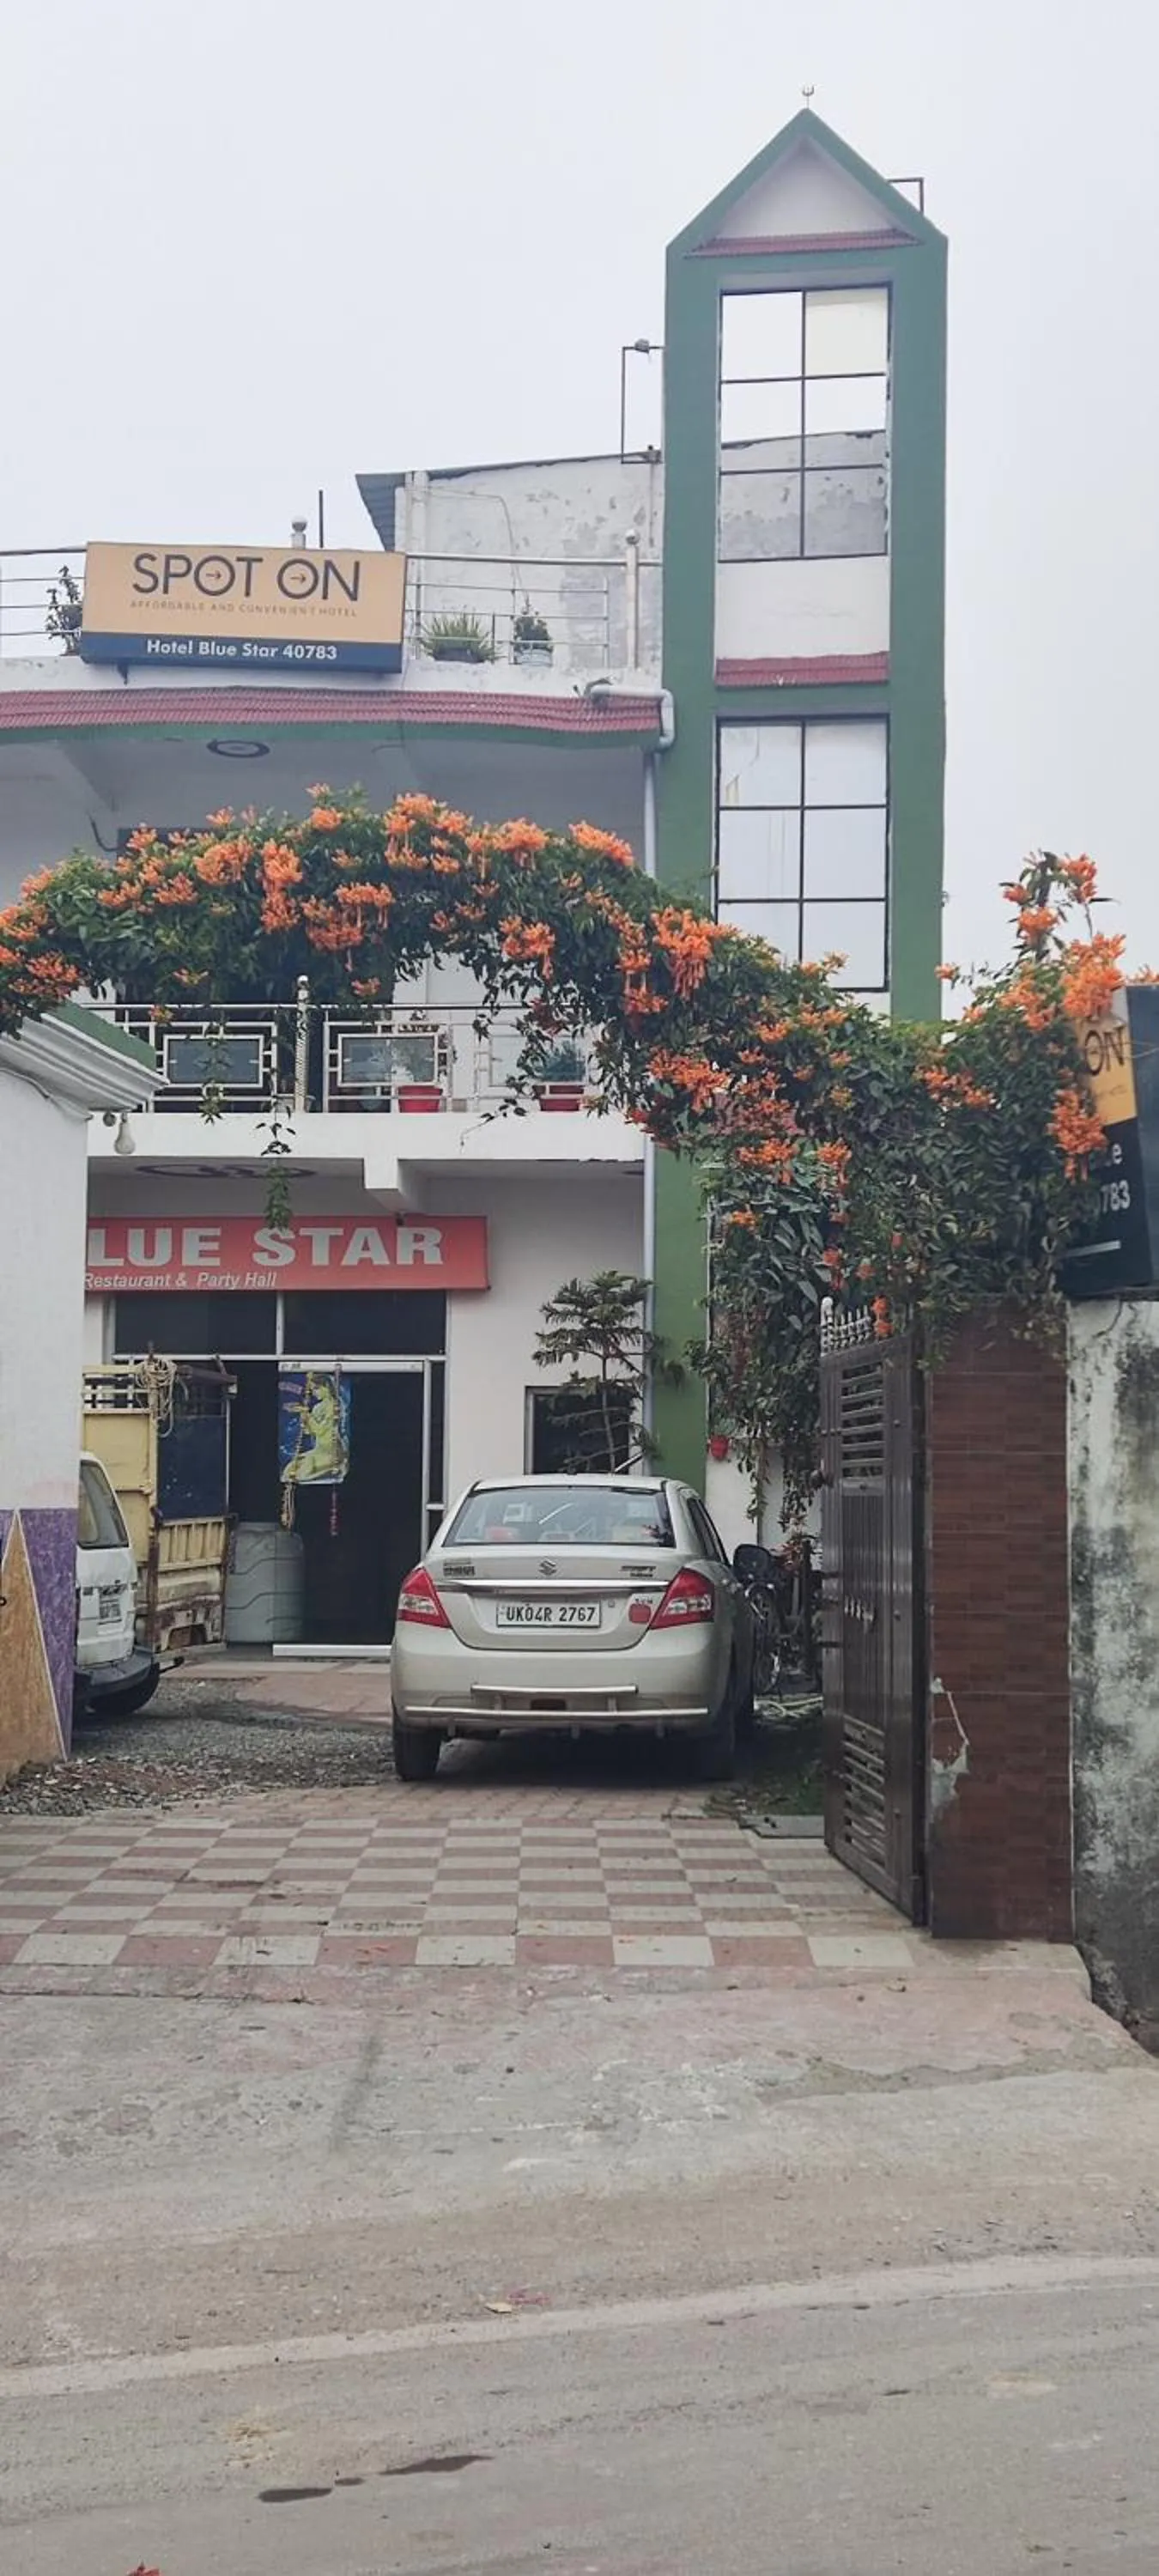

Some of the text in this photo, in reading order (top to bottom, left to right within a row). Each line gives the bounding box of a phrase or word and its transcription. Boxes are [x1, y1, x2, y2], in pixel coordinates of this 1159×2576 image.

[132, 552, 360, 601] SPOT ON
[130, 600, 205, 611] AFFORDABLE
[210, 603, 234, 612] AND
[319, 606, 357, 617] HOTEL
[147, 639, 337, 659] Hotel Blue Star 40783
[1084, 1025, 1126, 1076] ON
[252, 1227, 444, 1267] STAR
[84, 1272, 277, 1290] Restaurant & Party Hall
[507, 1607, 596, 1622] UK04R 2767
